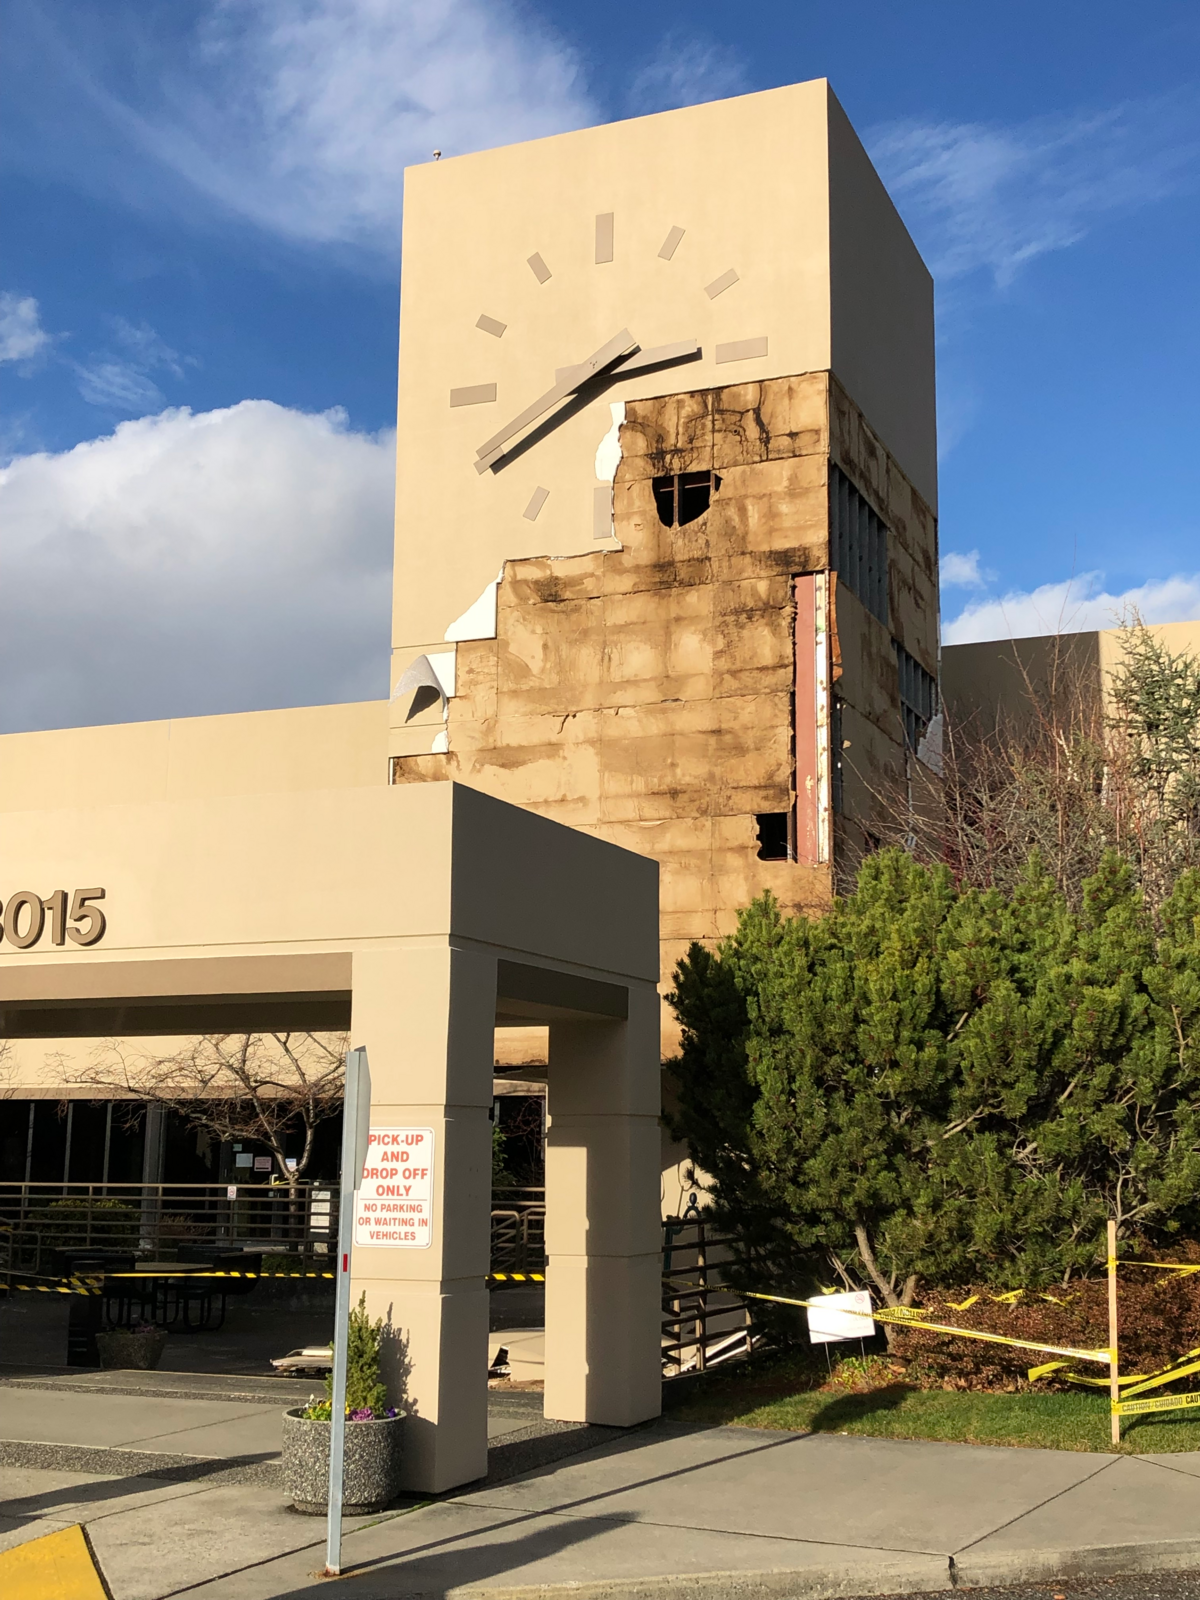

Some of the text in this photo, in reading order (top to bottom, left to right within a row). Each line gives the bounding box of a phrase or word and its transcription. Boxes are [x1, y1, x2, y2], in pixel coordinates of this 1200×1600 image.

[0, 887, 107, 950] 015
[368, 1134, 424, 1146] PICK-UP
[380, 1151, 410, 1163] AND
[362, 1167, 429, 1180] DROP OFF
[376, 1185, 412, 1197] ONLY
[363, 1203, 423, 1214] NO PARKING
[358, 1217, 428, 1227] OR WAITING IN
[369, 1231, 416, 1241] VEHICLES
